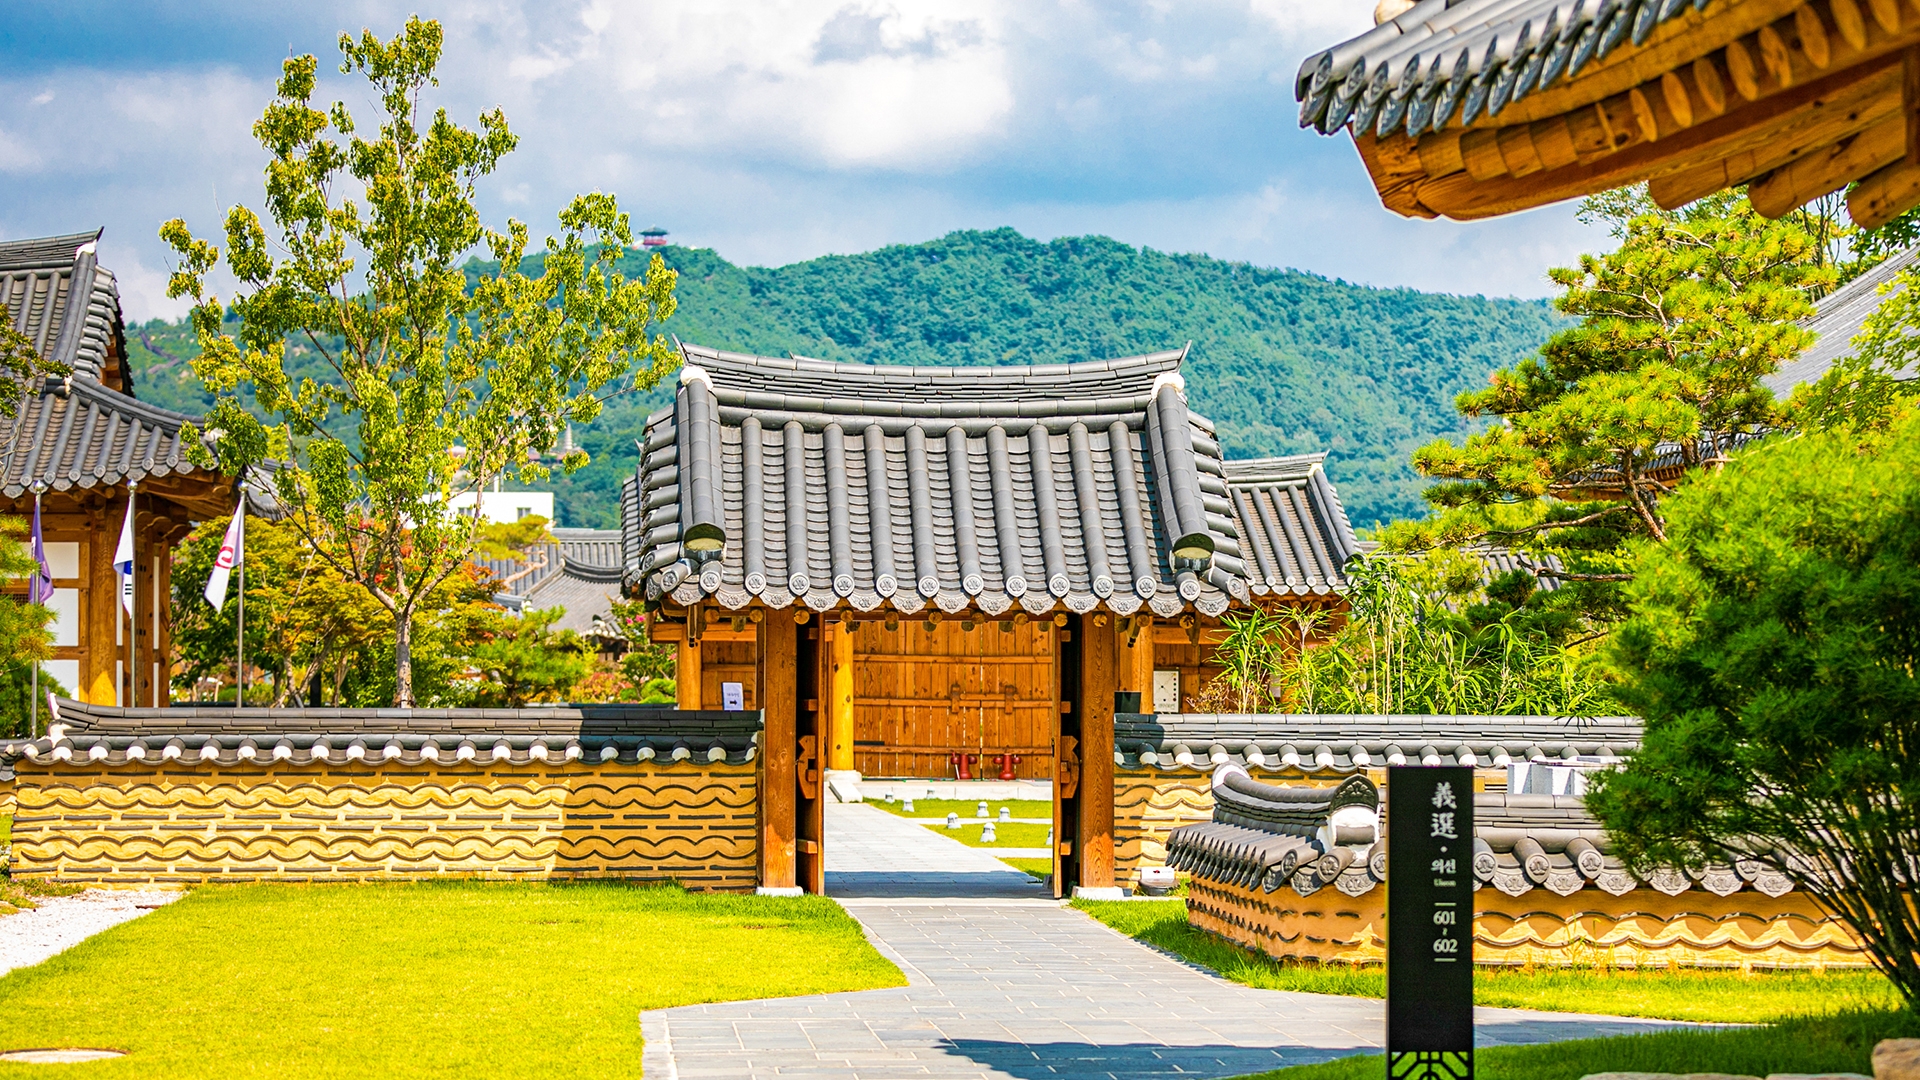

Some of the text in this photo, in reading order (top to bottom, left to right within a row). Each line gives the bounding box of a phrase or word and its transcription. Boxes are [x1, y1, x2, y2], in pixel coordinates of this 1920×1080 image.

[1431, 781, 1458, 840] 義選
[1430, 858, 1457, 875] 의선
[1433, 910, 1456, 925] 601
[1433, 938, 1458, 953] 602
